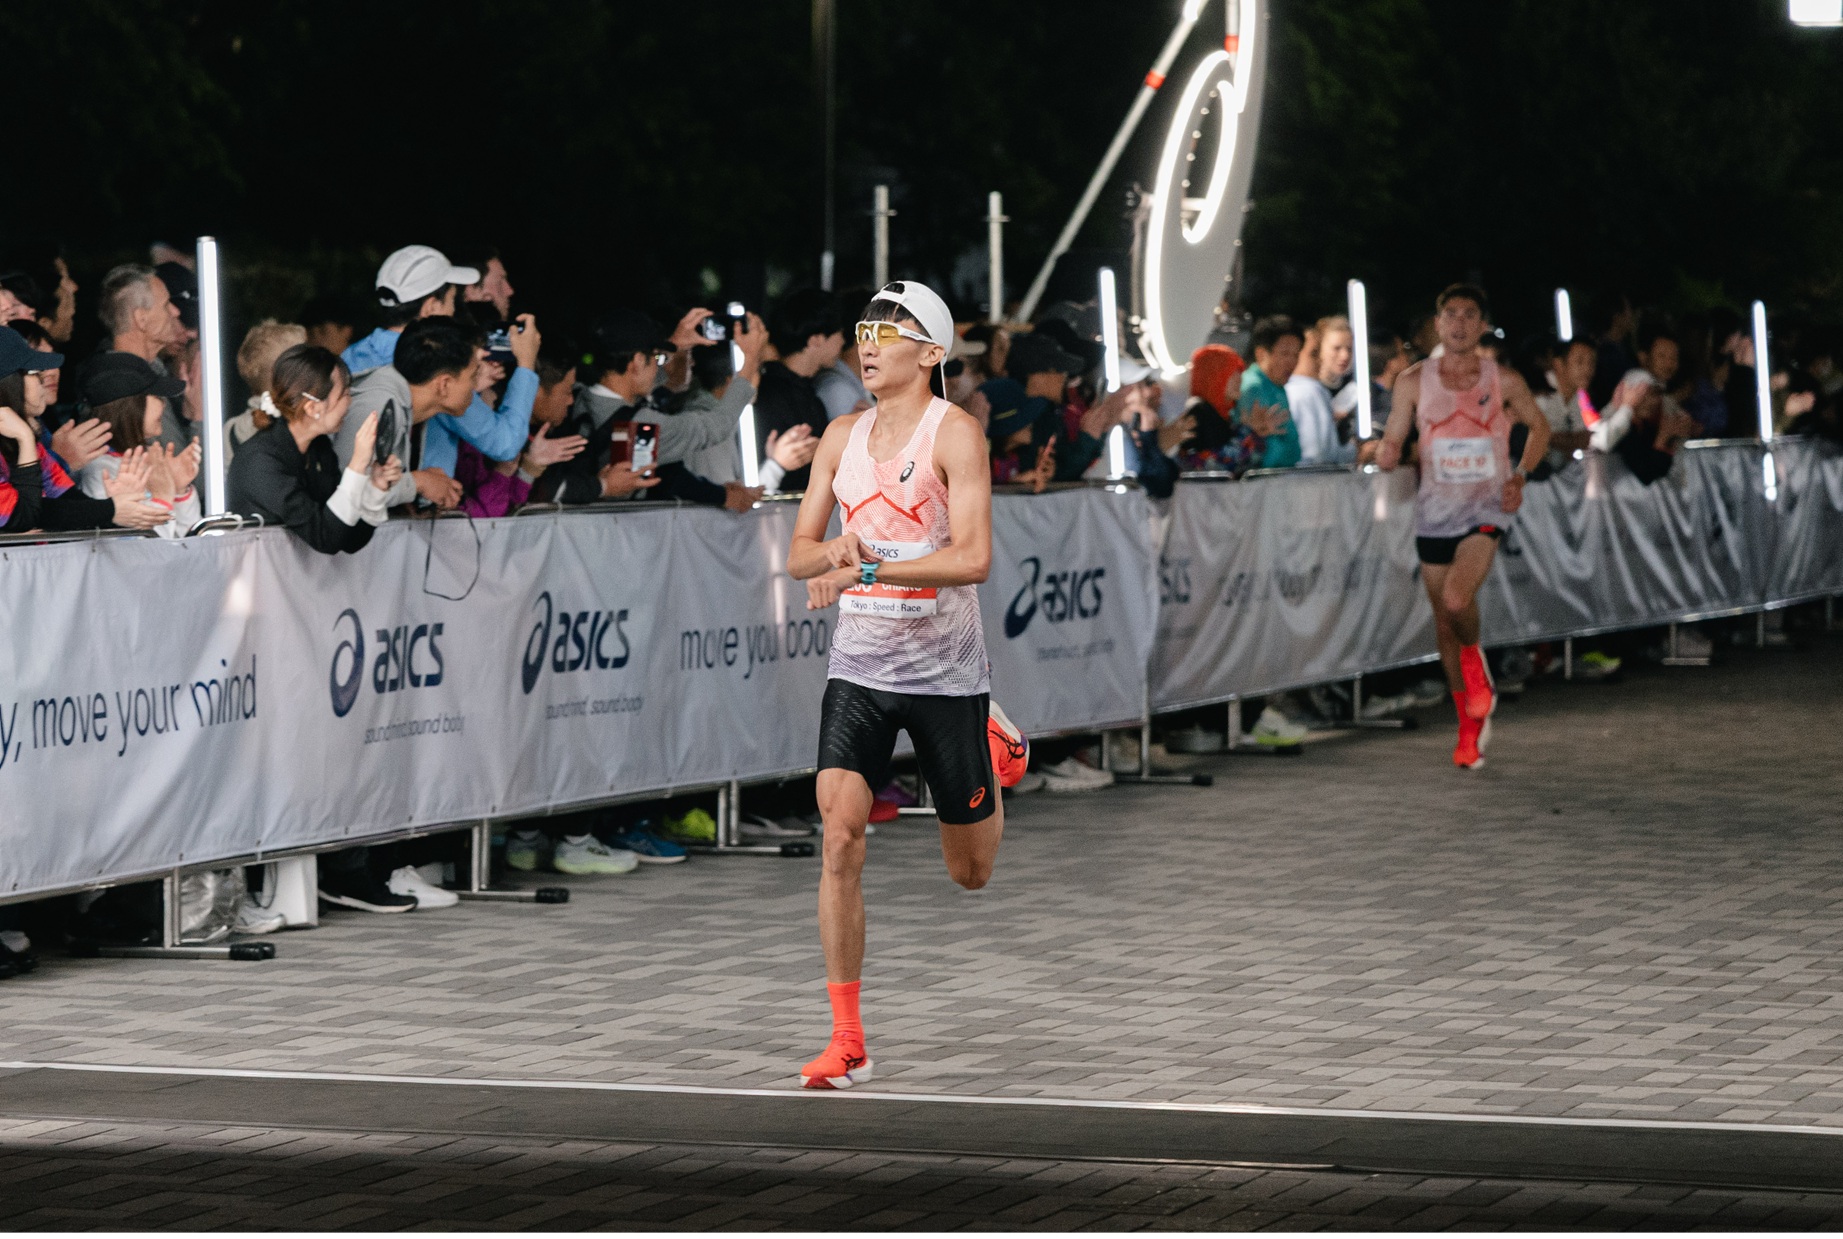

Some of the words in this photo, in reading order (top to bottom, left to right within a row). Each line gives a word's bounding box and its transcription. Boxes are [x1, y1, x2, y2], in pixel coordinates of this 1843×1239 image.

[850, 600, 868, 611] Tokyo
[872, 602, 895, 612] Speed
[900, 603, 922, 613] Race
[1041, 566, 1106, 625] asics
[372, 622, 445, 694] asics
[552, 608, 630, 674] asics
[743, 624, 783, 680] you
[33, 692, 108, 750] move
[115, 684, 181, 758] your
[189, 653, 257, 728] mind
